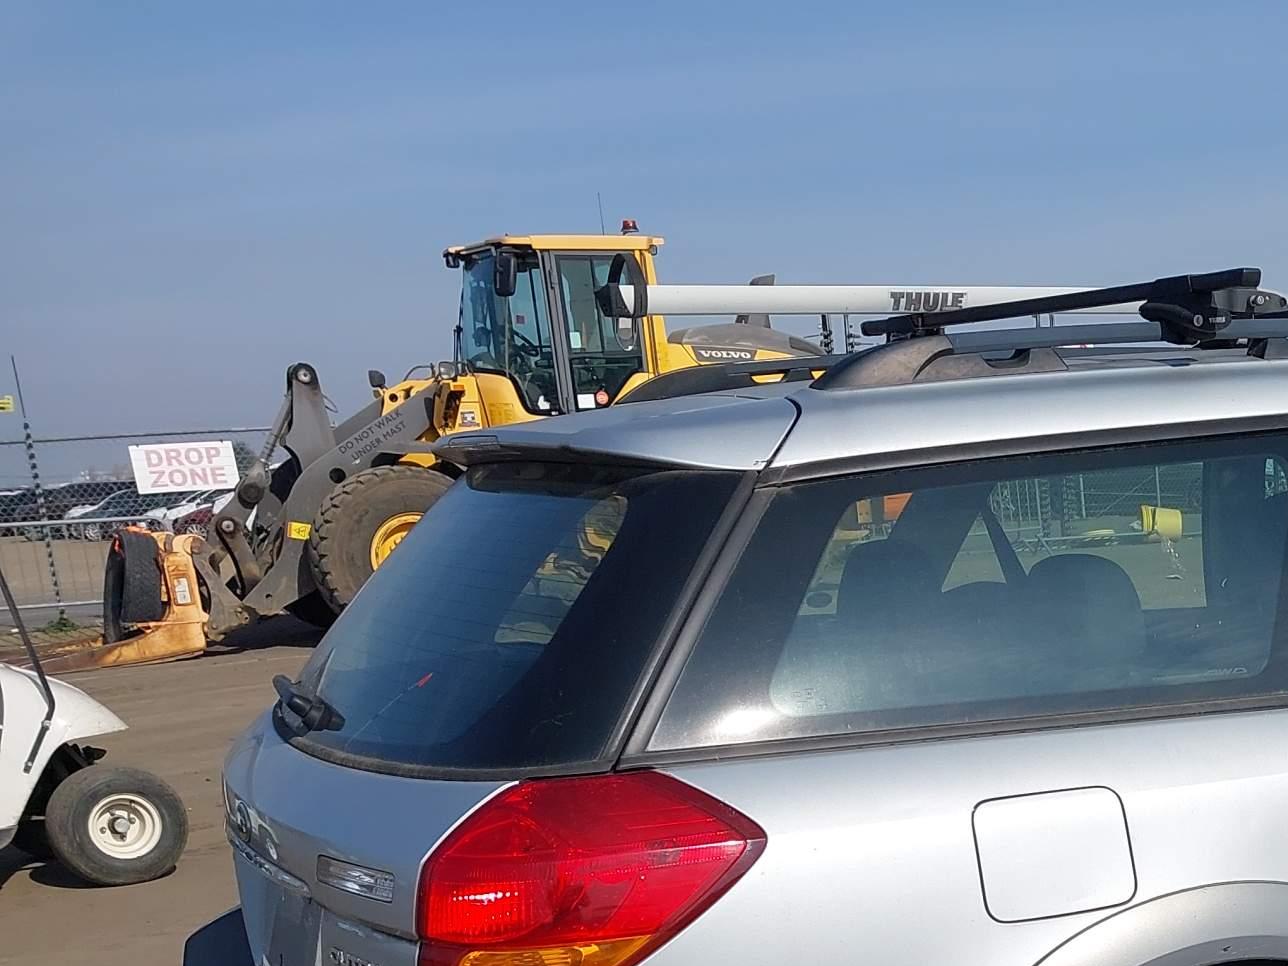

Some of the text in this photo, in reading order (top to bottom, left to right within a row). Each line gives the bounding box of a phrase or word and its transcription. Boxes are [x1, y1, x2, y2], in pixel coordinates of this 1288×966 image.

[890, 291, 967, 312] THULE
[698, 350, 752, 359] VOLVO
[338, 409, 403, 455] DO NOT WALK
[351, 421, 407, 460] UNDER MAST
[144, 446, 221, 468] DROP
[149, 466, 228, 488] ZONE
